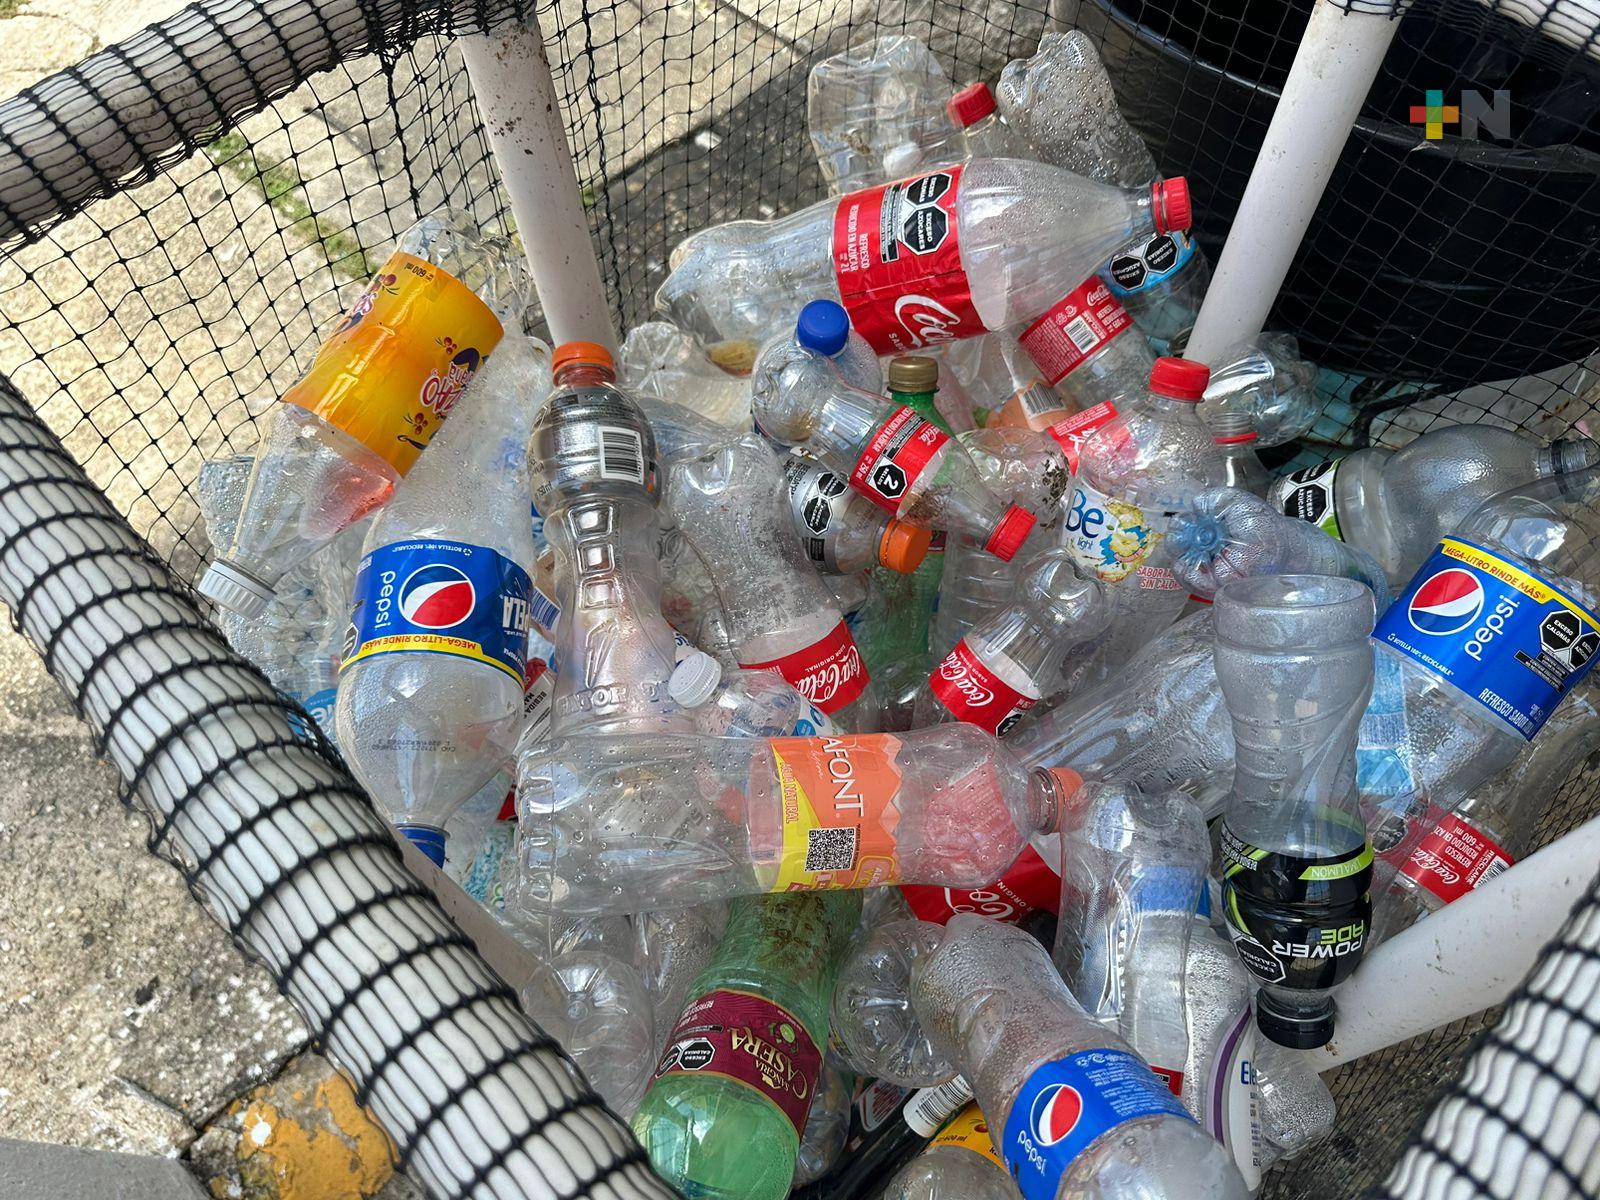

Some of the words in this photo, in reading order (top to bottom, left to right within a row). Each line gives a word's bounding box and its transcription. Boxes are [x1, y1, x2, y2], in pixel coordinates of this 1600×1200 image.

[882, 475, 900, 490] 2
[1065, 489, 1104, 538] Be
[1445, 544, 1490, 572] MEGA-LITRO
[1489, 565, 1518, 586] RINDE
[1141, 579, 1155, 590] SIN
[375, 570, 396, 629] pepsi
[1464, 596, 1519, 661] pepsi
[1546, 624, 1571, 644] CALORÍAS
[1553, 619, 1574, 636] EXCESO
[413, 636, 476, 650] MEGA-LITRO
[1393, 637, 1412, 651] BOTELLA
[805, 655, 835, 673] ORIGINAL
[1478, 687, 1513, 718] REFRESCO
[784, 785, 798, 824] NATURAL
[1451, 836, 1479, 859] REDUCIDO
[1461, 832, 1477, 845] 600
[1444, 845, 1472, 868] REFRESCO
[1320, 920, 1364, 944] ADE
[1271, 935, 1363, 958] POWER
[728, 1026, 807, 1100] CASERA
[1017, 1129, 1047, 1176] pepsi
